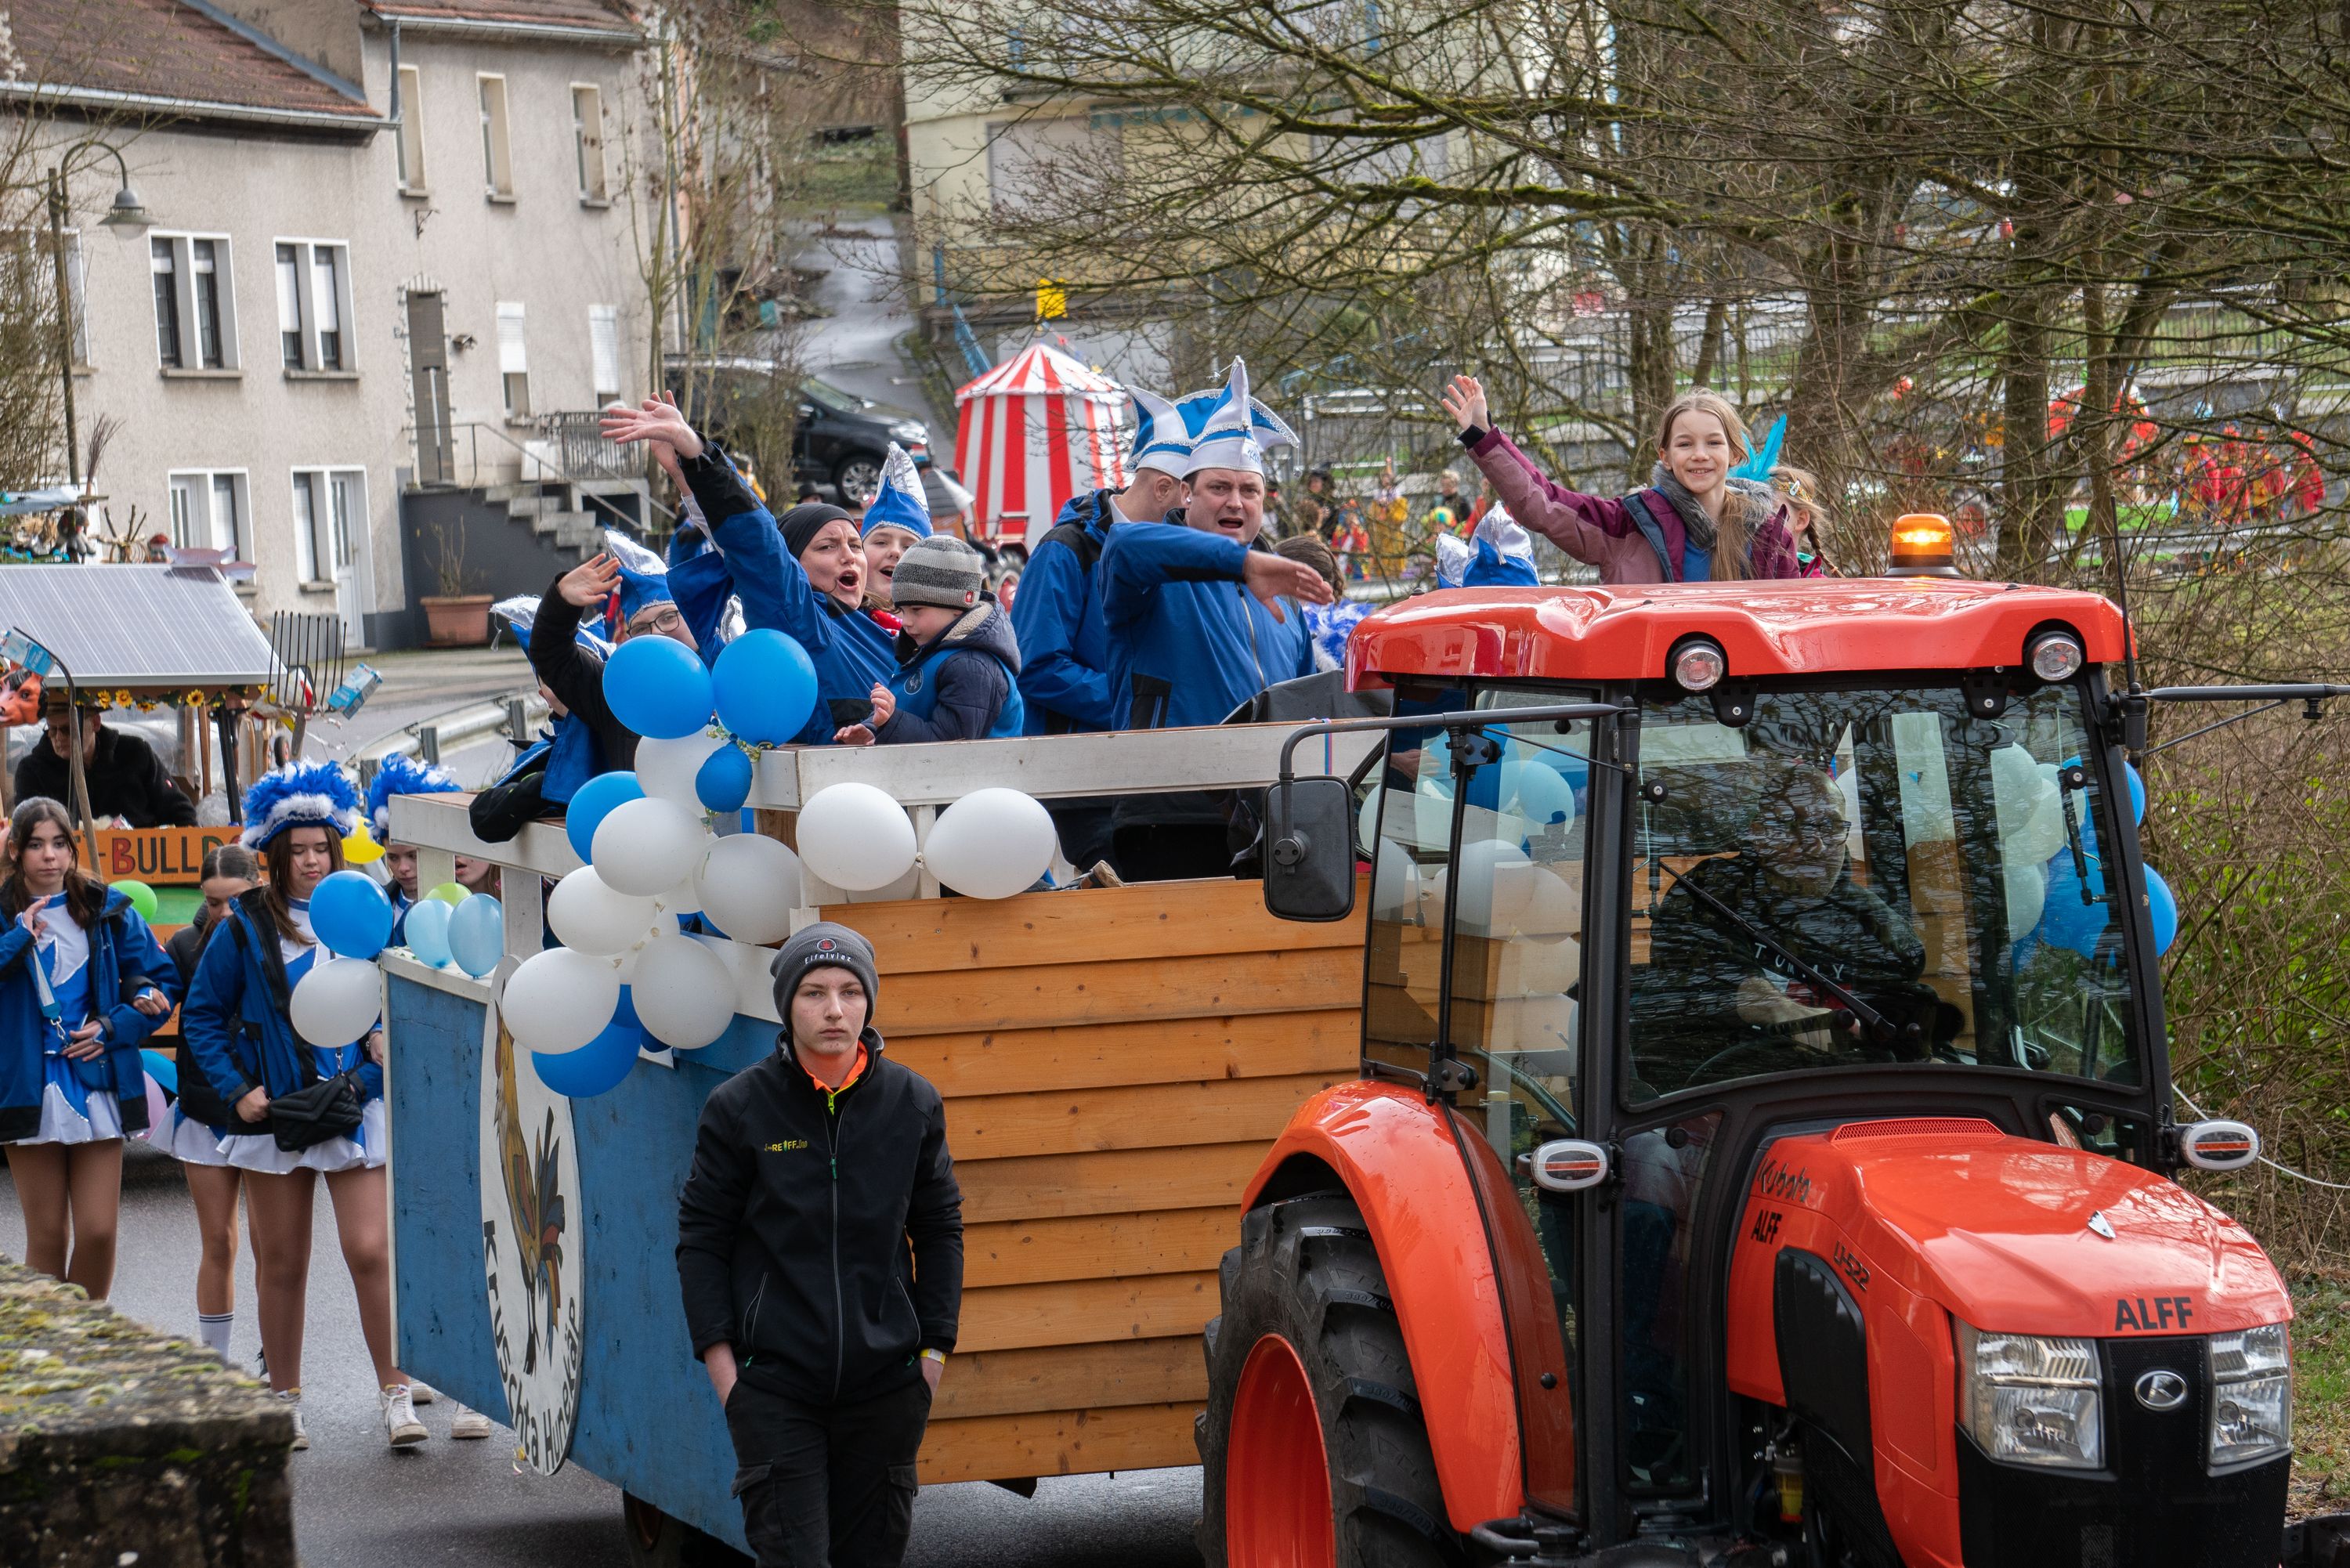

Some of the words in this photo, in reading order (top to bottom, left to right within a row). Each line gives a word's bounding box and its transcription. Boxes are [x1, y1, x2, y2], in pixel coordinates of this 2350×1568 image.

[1758, 1158, 1812, 1204] Kubota
[1751, 1209, 1783, 1245] ALFF
[2115, 1296, 2193, 1331] ALFF
